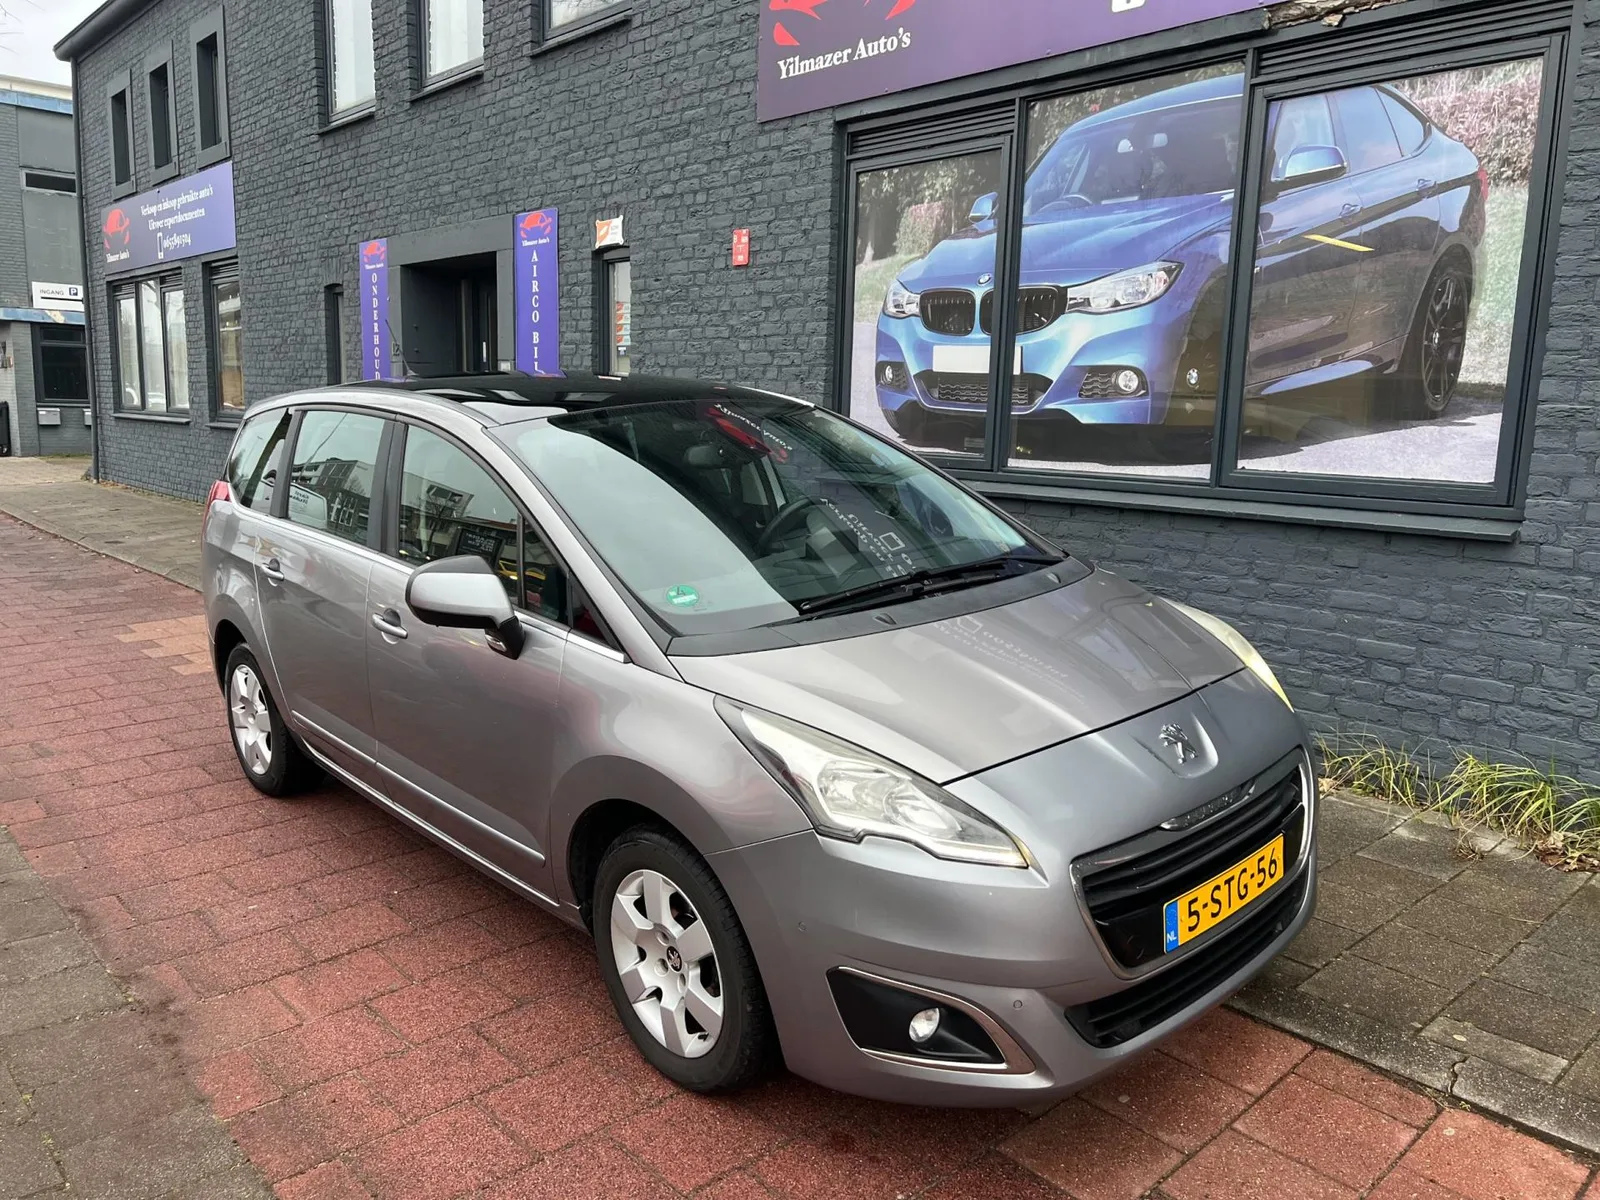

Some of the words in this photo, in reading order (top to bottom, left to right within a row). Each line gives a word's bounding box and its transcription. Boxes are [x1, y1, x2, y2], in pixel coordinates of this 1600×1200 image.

[777, 47, 852, 80] Yilmazer
[853, 27, 912, 61] Auto's
[531, 249, 540, 323] AIRCO
[371, 272, 381, 380] ONDERHOUD
[1187, 847, 1278, 932] 5-STG-56
[1166, 930, 1178, 944] NL
